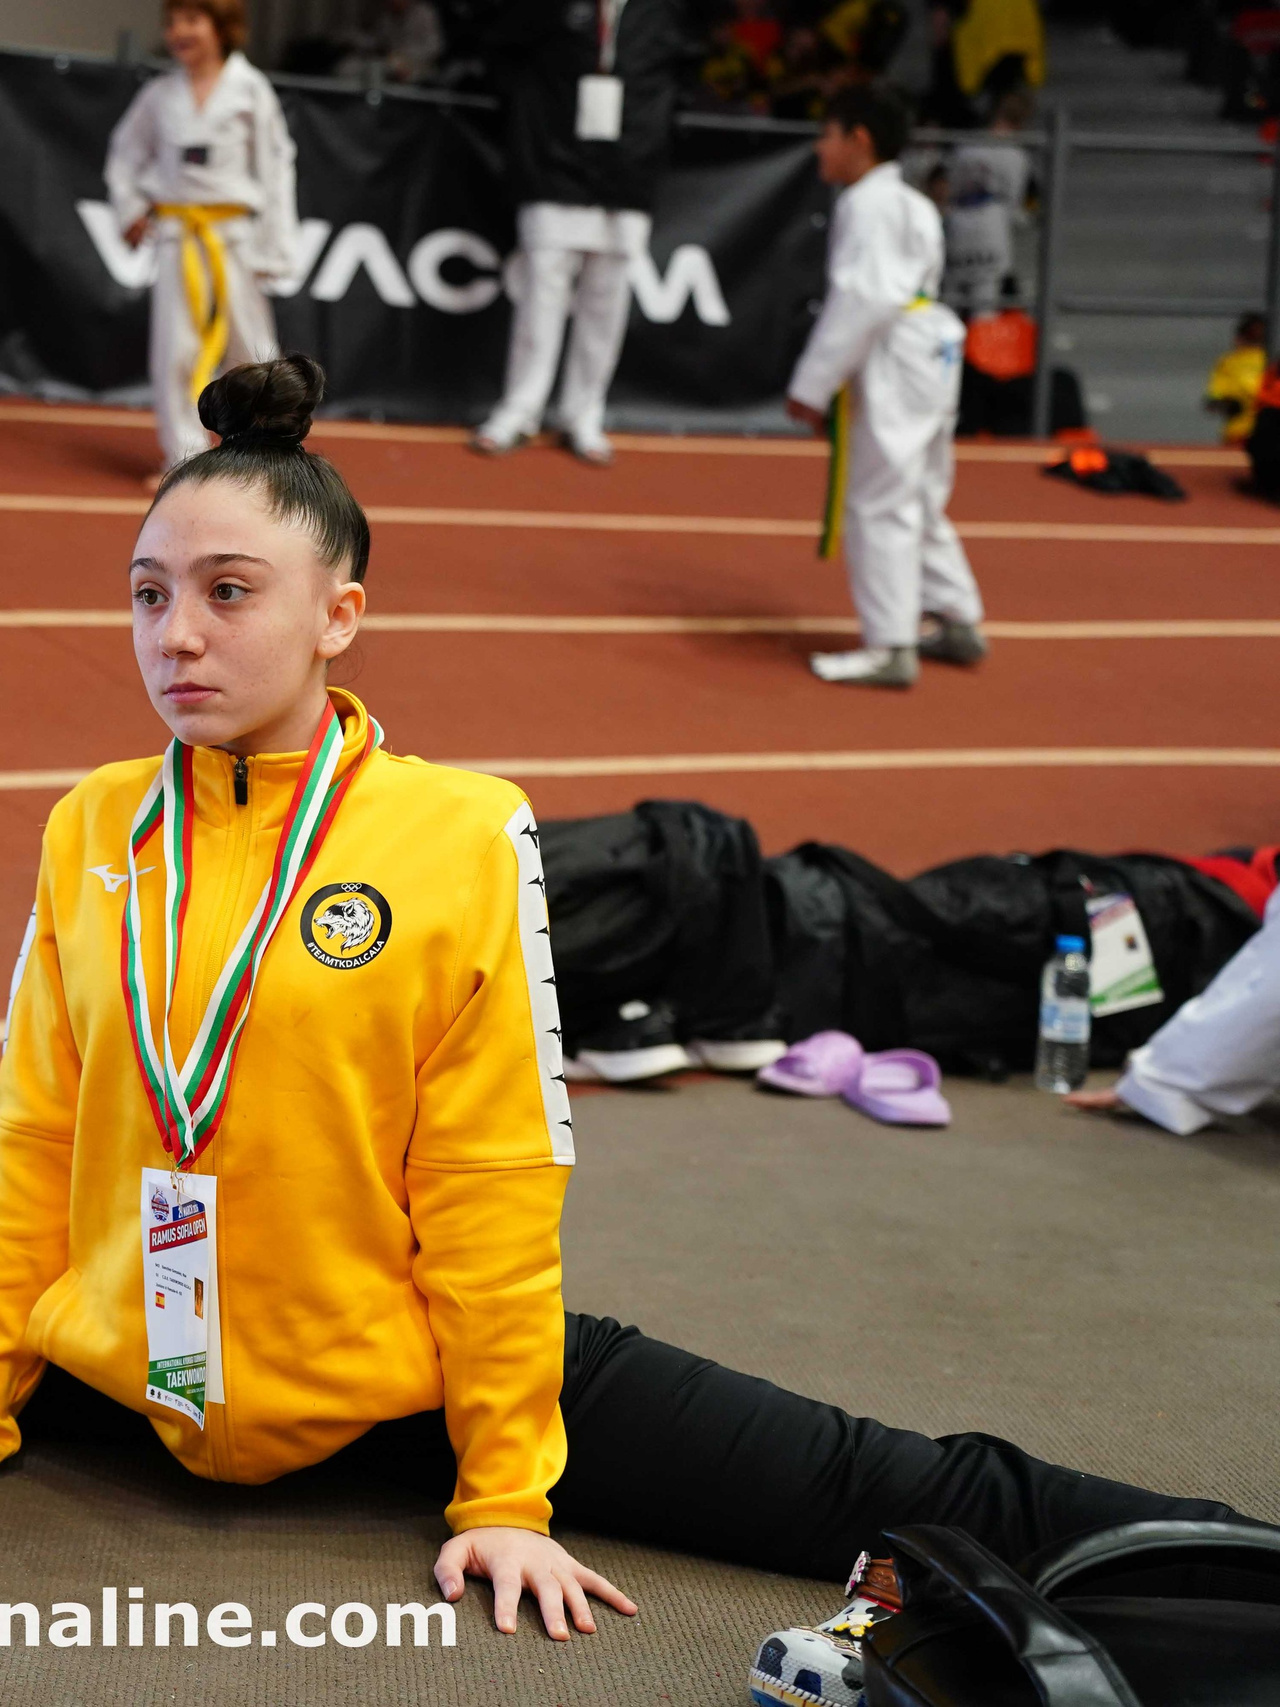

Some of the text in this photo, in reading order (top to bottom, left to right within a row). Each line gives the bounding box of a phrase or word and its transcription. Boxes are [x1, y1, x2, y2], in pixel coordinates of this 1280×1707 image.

[307, 940, 385, 968] #TEAMTKDALCALA
[152, 1218, 206, 1246] RAMUS SOFIA OPEN
